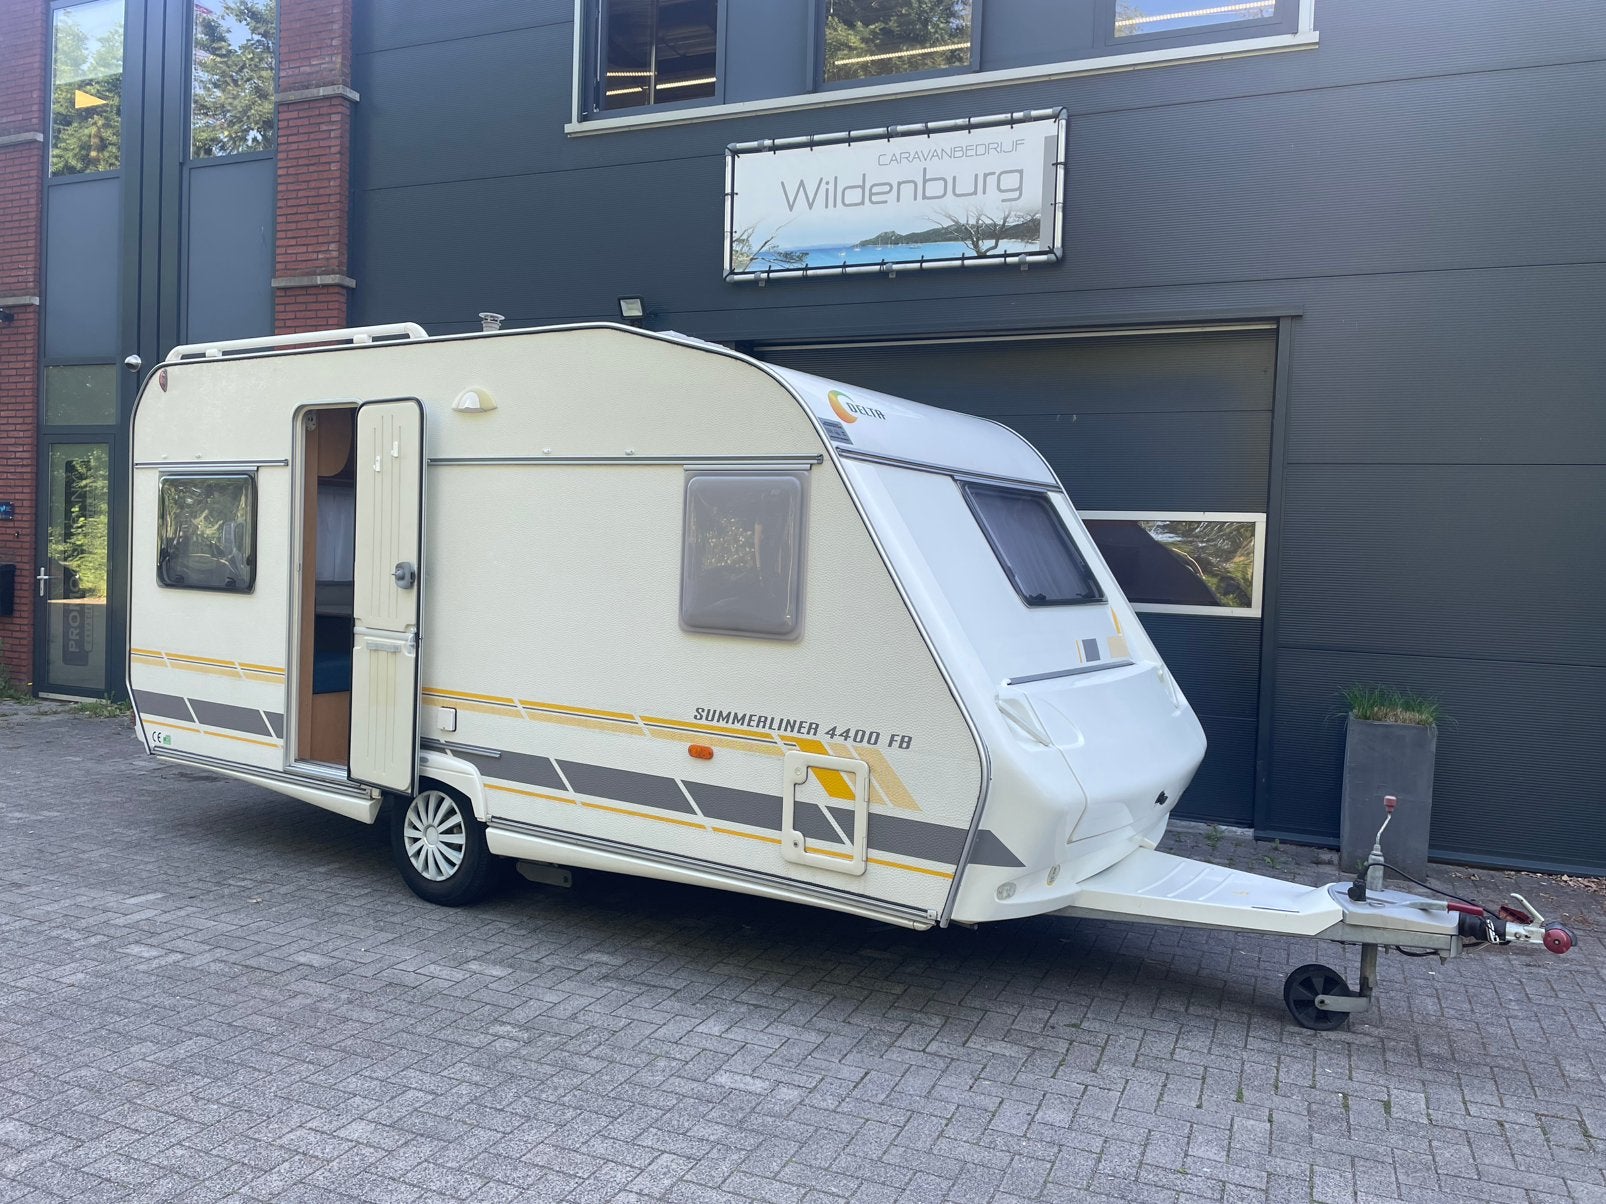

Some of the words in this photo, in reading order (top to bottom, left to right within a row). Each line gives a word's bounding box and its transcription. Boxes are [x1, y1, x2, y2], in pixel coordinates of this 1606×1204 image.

[877, 138, 1026, 167] CARAVANBEDRIJF
[780, 167, 1024, 213] Wildenburg
[846, 402, 886, 420] DELTA
[693, 707, 820, 737] SUMMERLINER
[824, 725, 881, 746] 4400
[887, 733, 913, 750] FB
